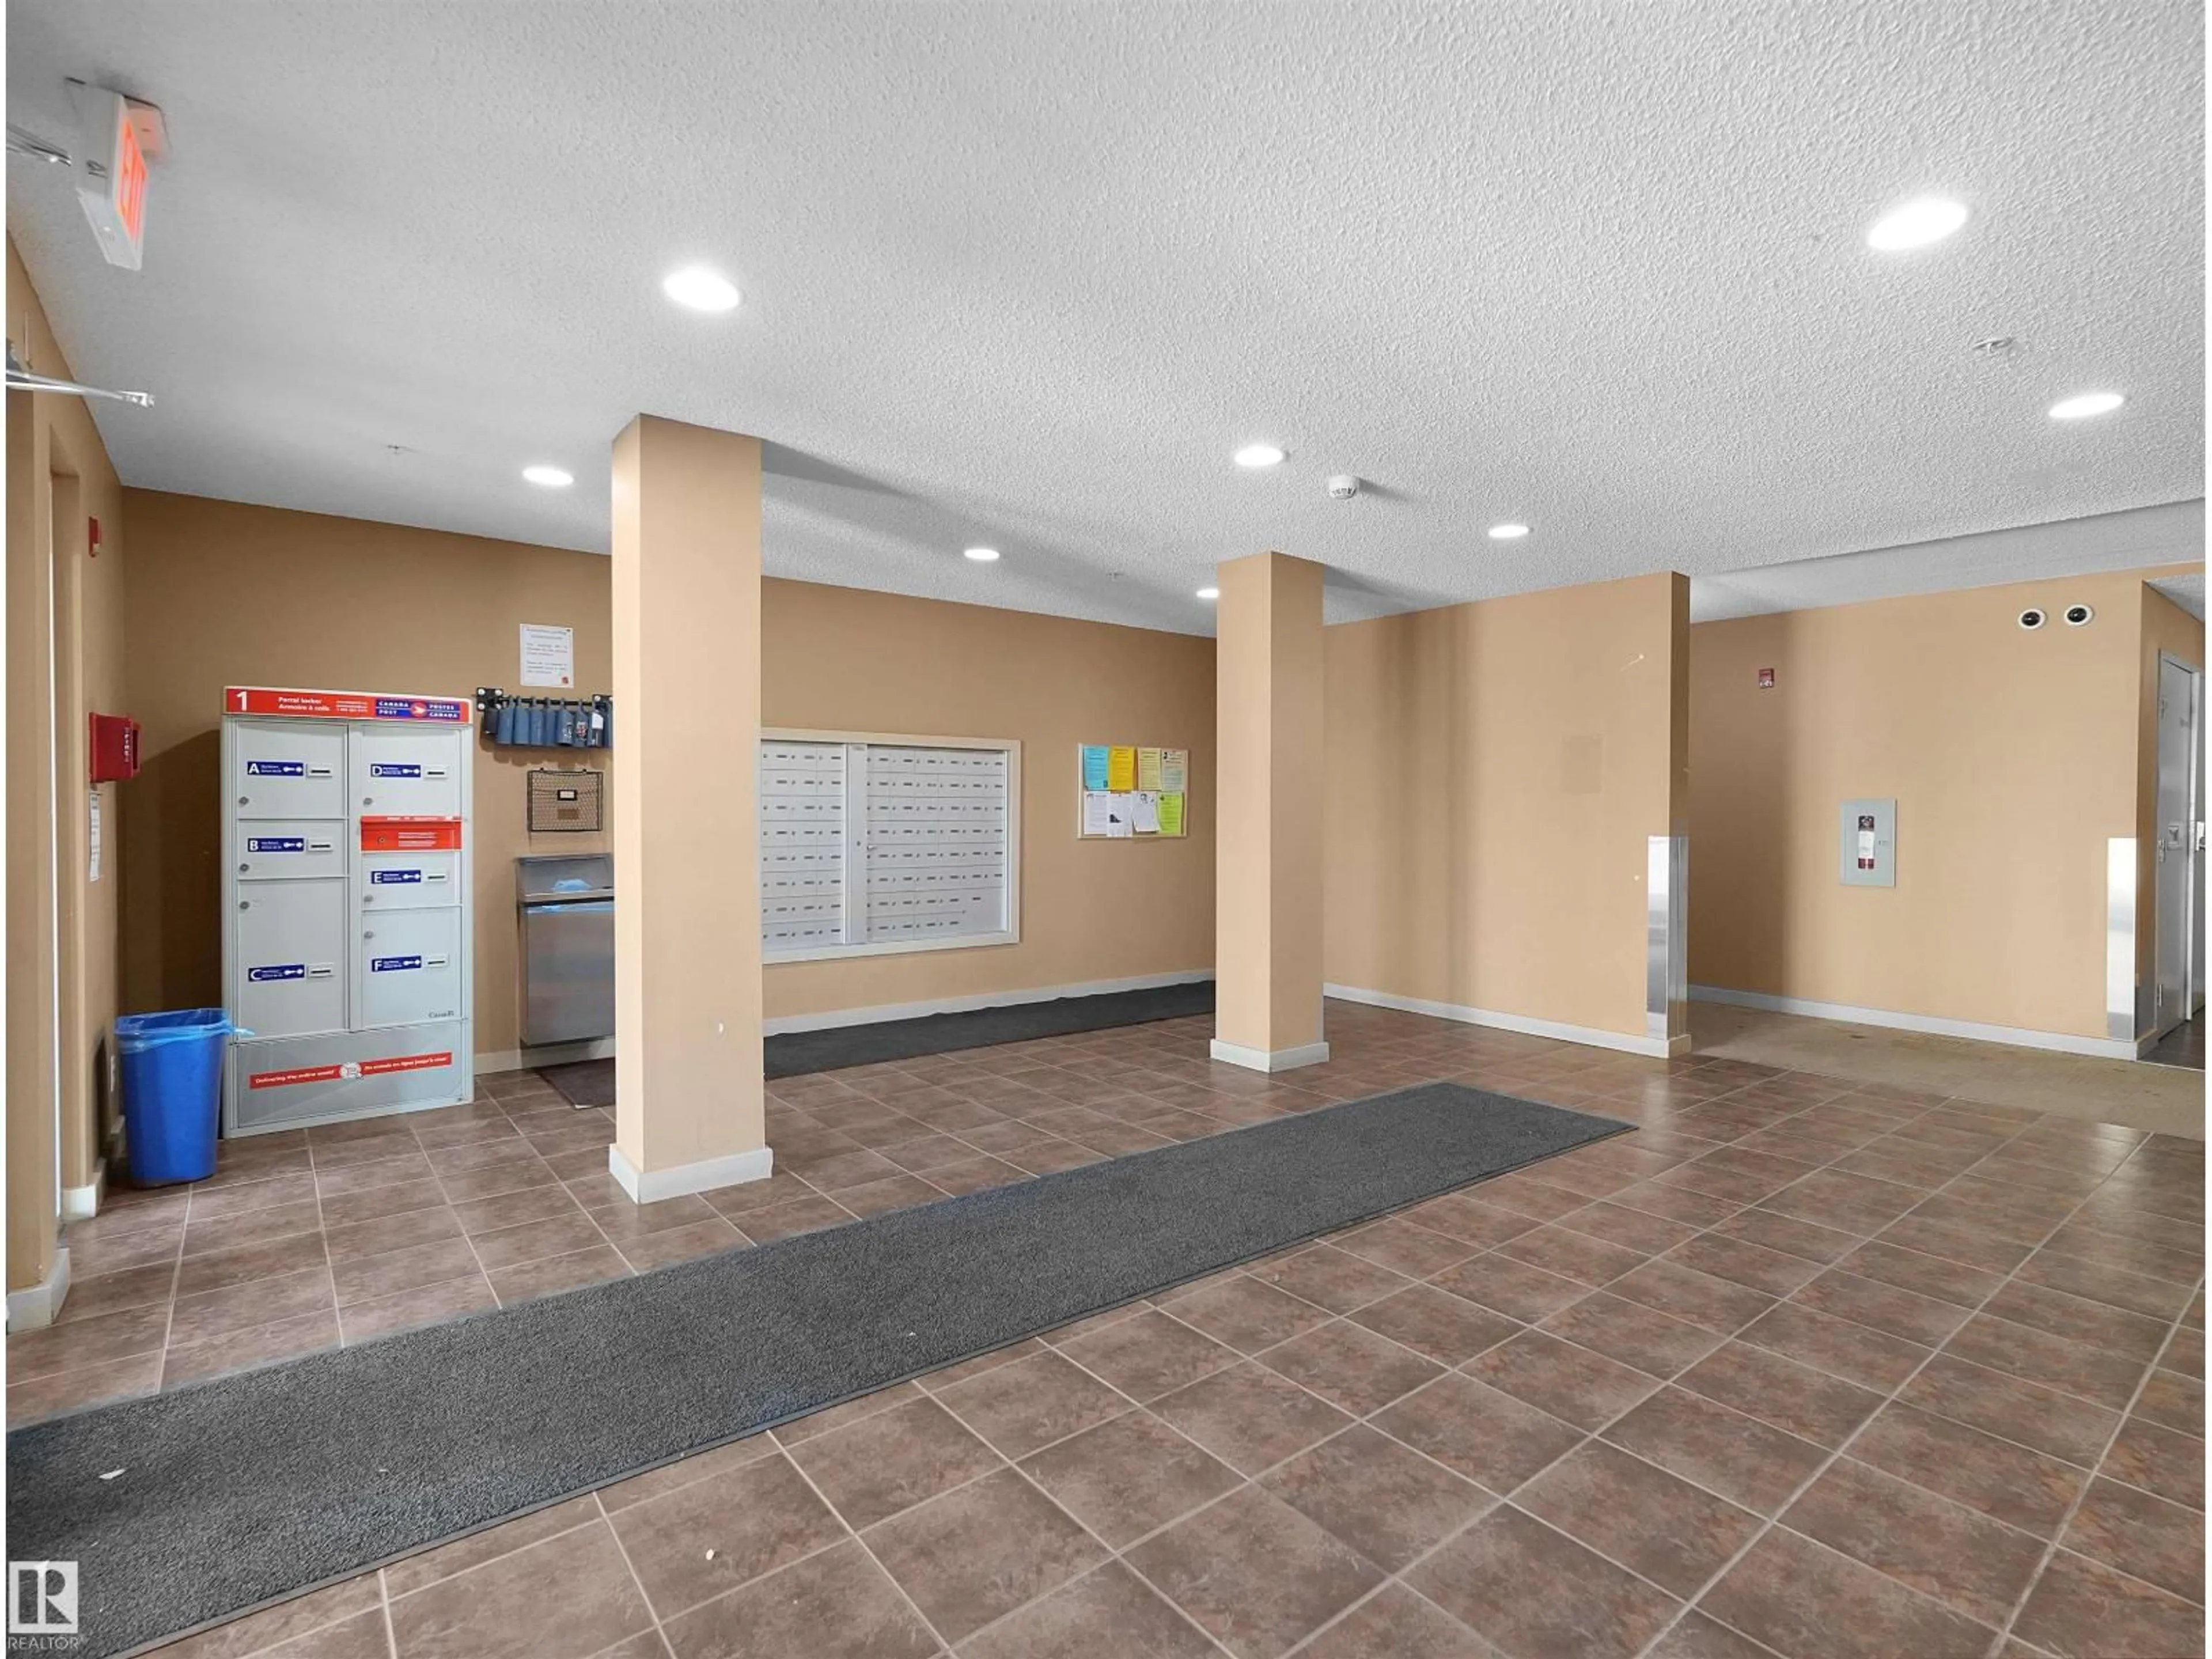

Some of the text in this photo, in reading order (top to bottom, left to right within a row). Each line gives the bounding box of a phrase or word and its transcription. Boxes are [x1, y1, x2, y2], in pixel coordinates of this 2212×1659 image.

[237, 691, 247, 711] 1
[249, 763, 259, 773] A
[372, 766, 382, 775] D
[250, 840, 258, 850] B
[374, 873, 382, 882] E
[375, 961, 382, 971] F
[251, 969, 262, 979] C
